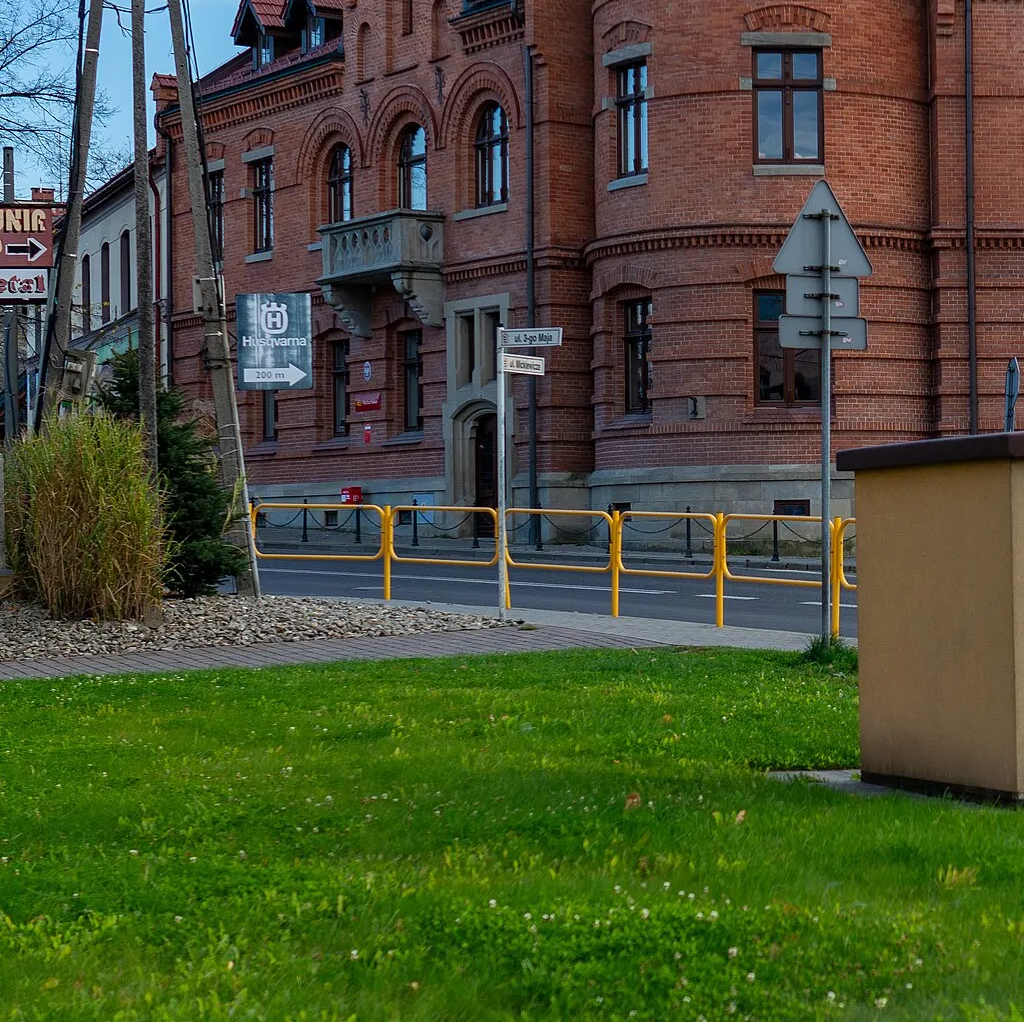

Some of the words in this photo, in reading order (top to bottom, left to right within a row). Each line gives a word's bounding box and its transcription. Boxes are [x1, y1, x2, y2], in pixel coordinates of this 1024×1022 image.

[242, 336, 307, 348] Husqvarna
[514, 334, 522, 343] ul.
[523, 333, 537, 345] 3-go
[538, 333, 553, 344] Maja
[256, 371, 272, 379] 200
